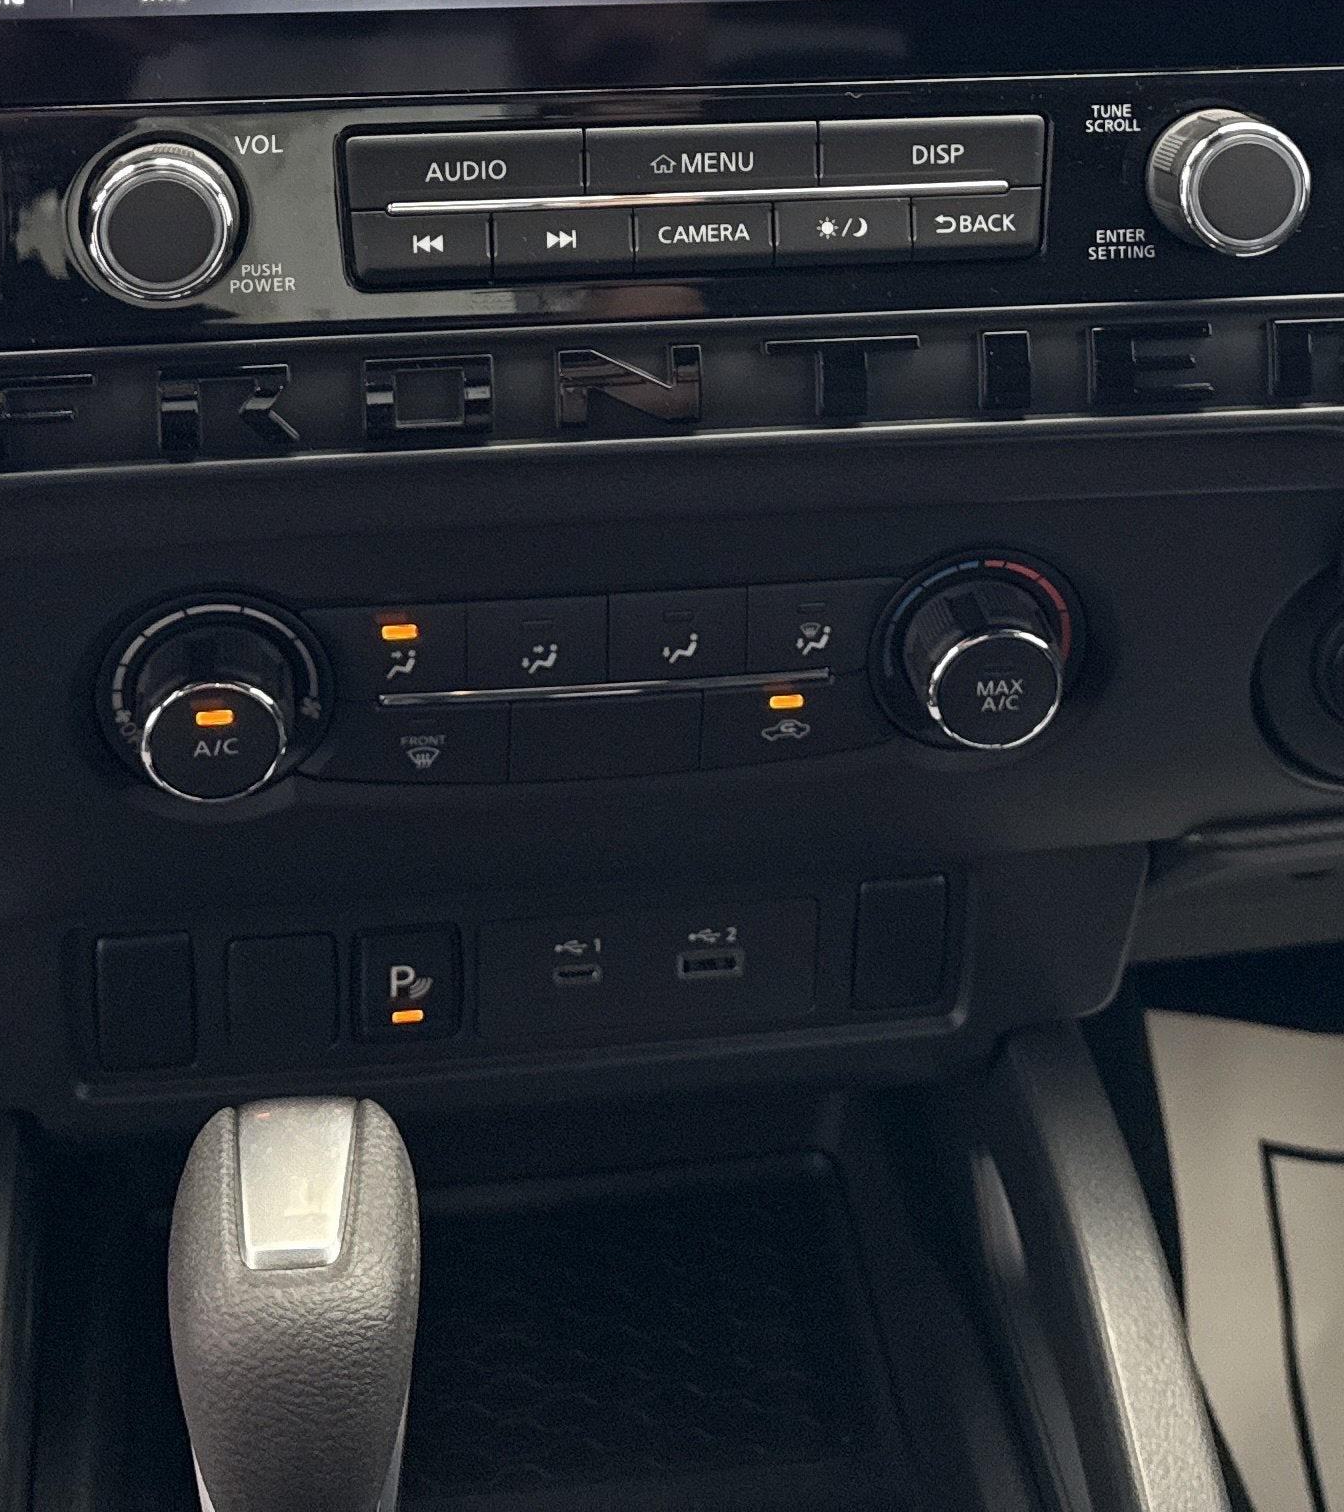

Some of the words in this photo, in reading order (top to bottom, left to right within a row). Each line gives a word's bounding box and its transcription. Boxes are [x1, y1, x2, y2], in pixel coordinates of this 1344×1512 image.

[1090, 103, 1132, 118] TUNE
[1085, 118, 1141, 133] SCROLL
[234, 134, 284, 156] VOL
[680, 151, 755, 174] MENU
[912, 144, 965, 165] DISP
[425, 159, 507, 183] AUDIO
[959, 213, 1016, 233] BACK
[658, 223, 751, 244] CAMERA
[1096, 228, 1146, 244] ENTER
[1088, 244, 1156, 261] SETTING
[241, 263, 283, 277] PUSH
[229, 276, 296, 294] POWER
[976, 679, 1024, 697] MAX
[981, 694, 1020, 713] A/C
[193, 737, 240, 759] A/C
[401, 734, 446, 747] FRONT
[725, 927, 737, 942] 2
[593, 938, 602, 953] 1
